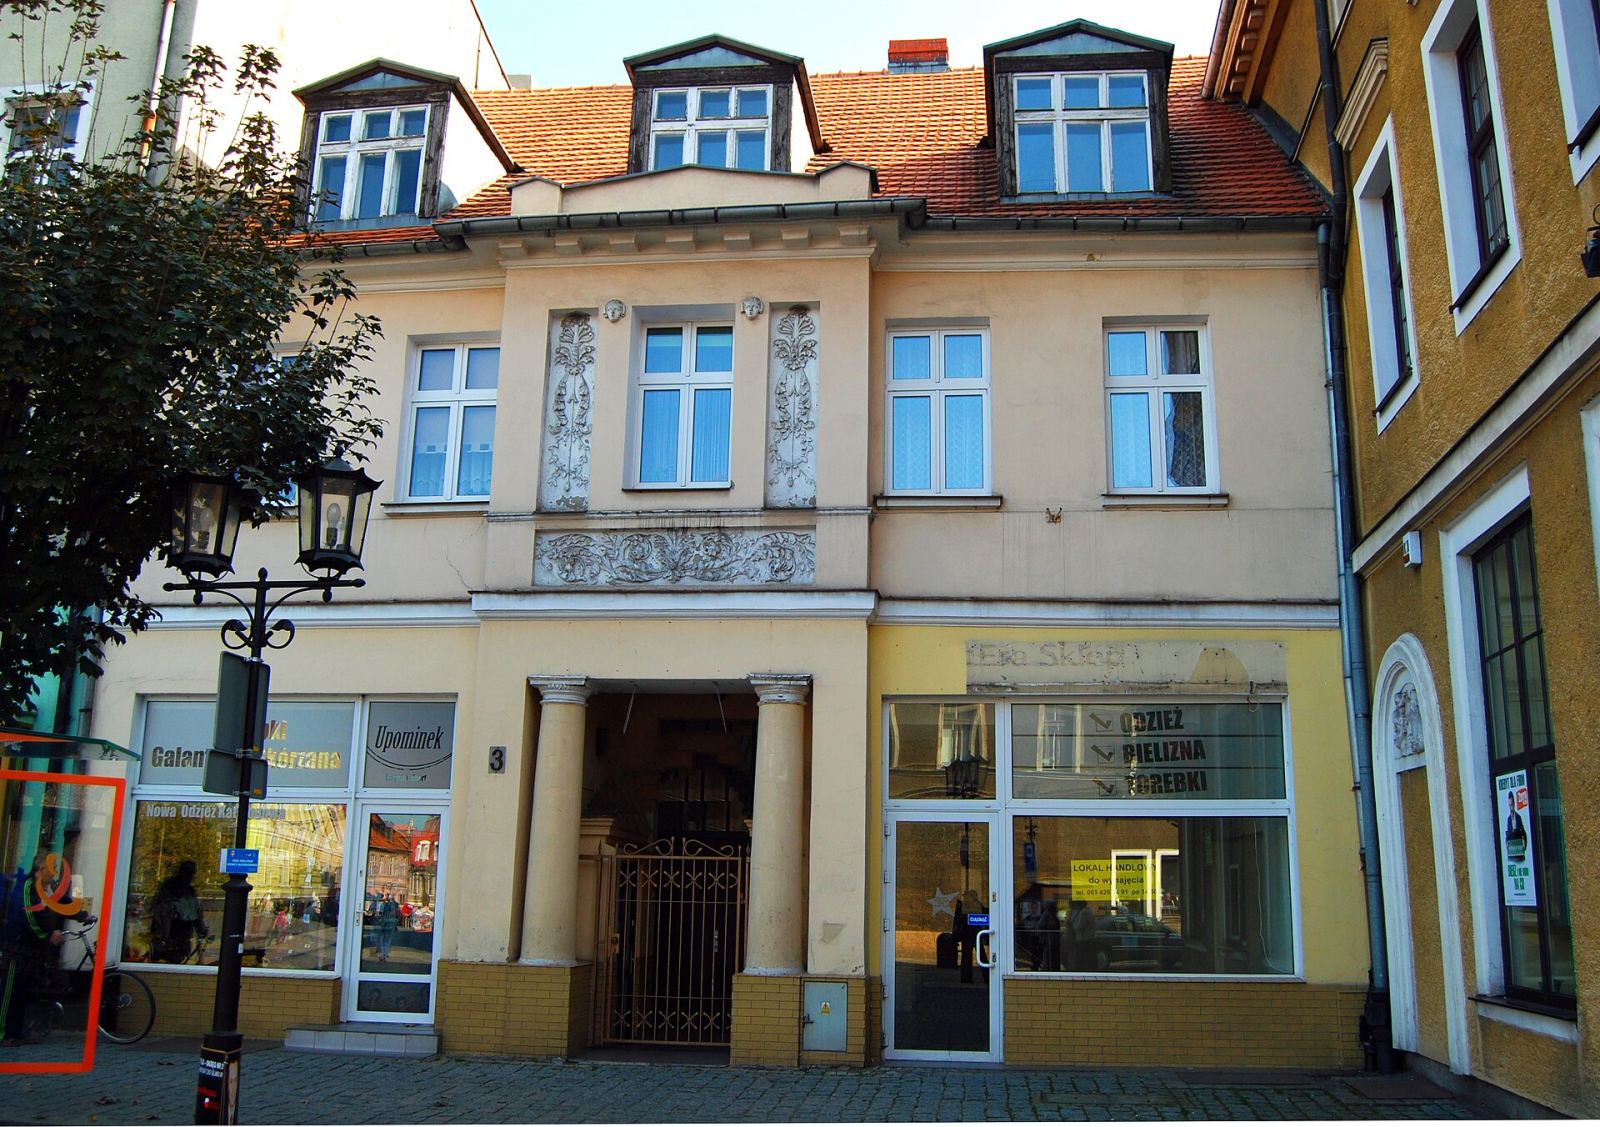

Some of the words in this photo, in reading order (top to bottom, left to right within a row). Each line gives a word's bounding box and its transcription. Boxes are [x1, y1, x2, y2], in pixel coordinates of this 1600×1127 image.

[1120, 706, 1184, 733] ODZIEŻ
[375, 726, 445, 752] Upominek
[152, 746, 207, 768] Galan
[265, 747, 341, 769] kórzana
[490, 749, 503, 771] 3
[1122, 740, 1207, 764] BIELIZNA
[146, 804, 176, 818] Nowa
[181, 803, 217, 819] Odzież
[1073, 864, 1104, 872] LOKAL
[1088, 876, 1100, 884] do
